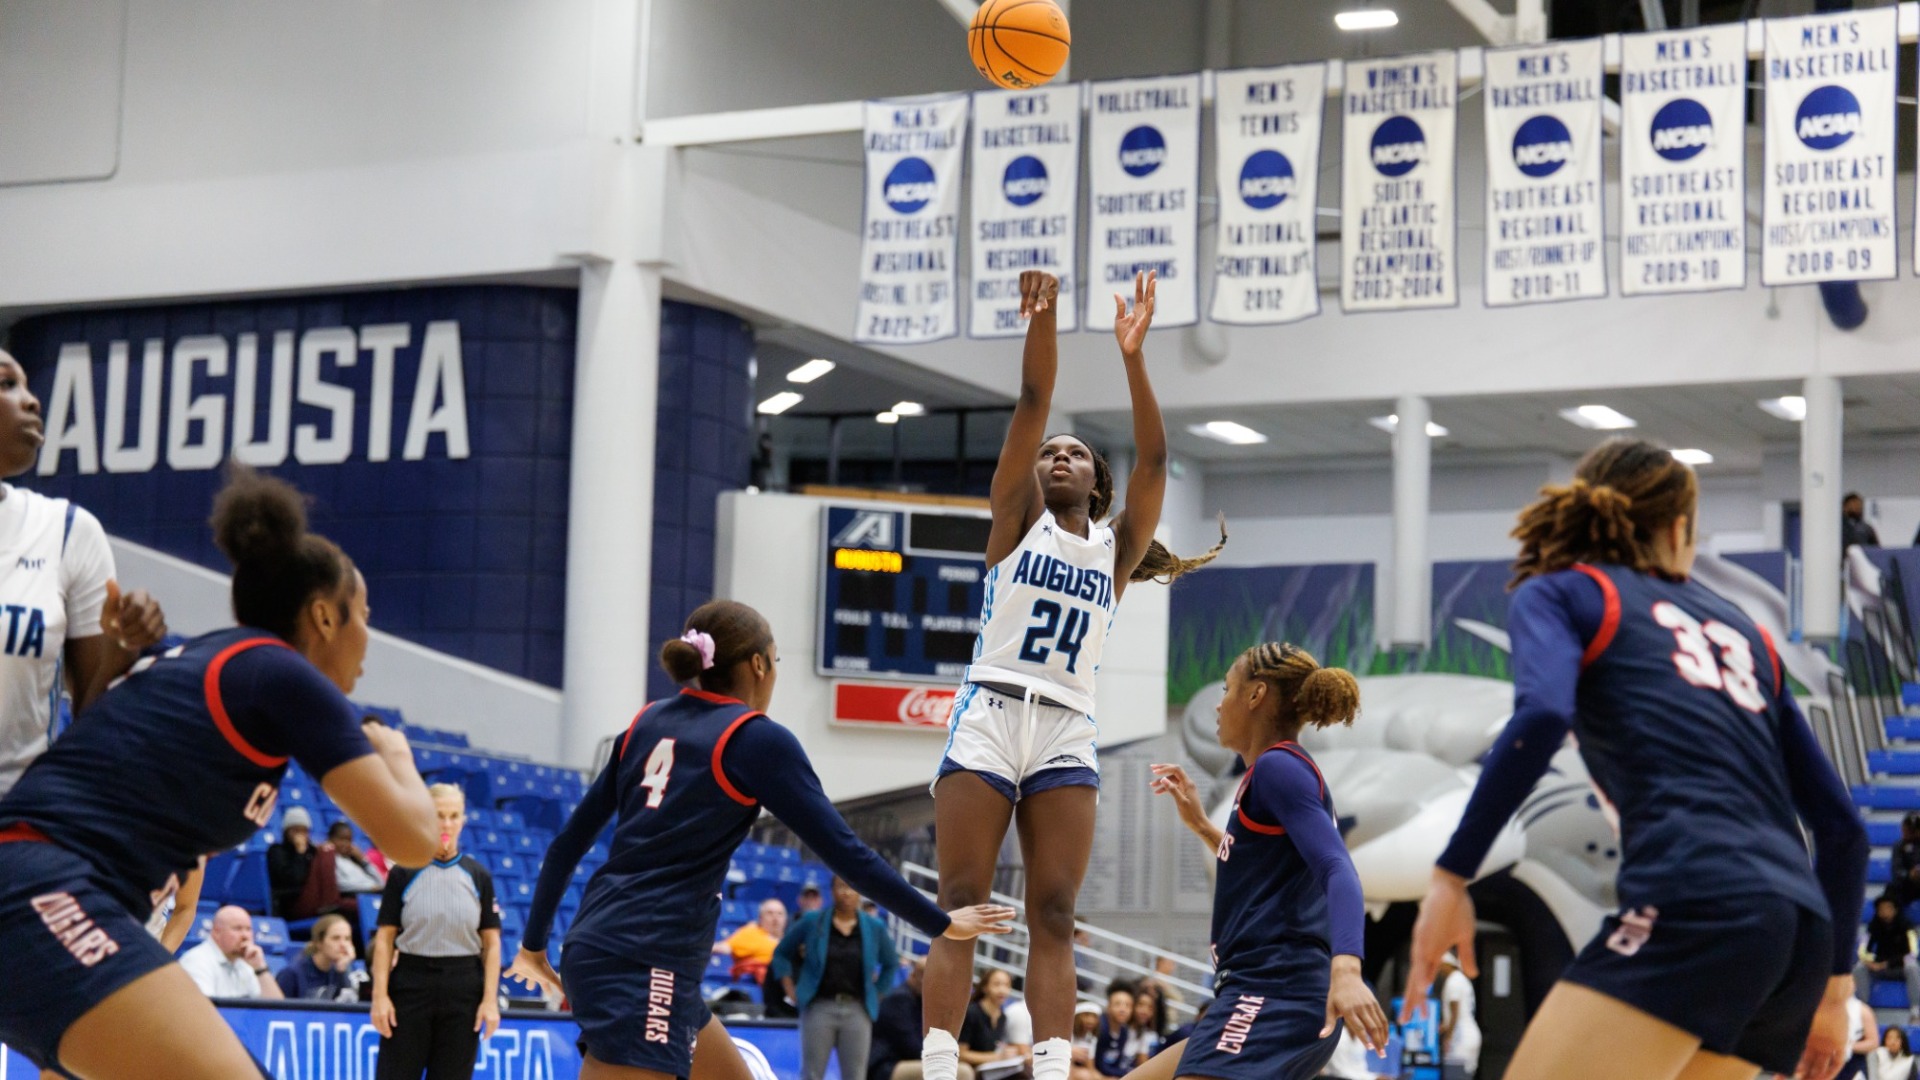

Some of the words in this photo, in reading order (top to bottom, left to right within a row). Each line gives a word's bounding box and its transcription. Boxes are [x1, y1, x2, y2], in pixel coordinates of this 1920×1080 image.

[1801, 22, 1860, 46] MEN'S
[1656, 37, 1711, 60] MEN'S
[1367, 63, 1438, 88] WOMEN'S
[1517, 54, 1570, 77] MEN'S
[1770, 50, 1889, 79] BASKETBALL
[1626, 64, 1737, 93] BASKETBALL
[1099, 88, 1188, 111] VOLLEYBALL
[1247, 80, 1294, 103] MEN'S
[1349, 87, 1452, 114] BASKETBALL
[1492, 80, 1596, 107] BASKETBALL
[1240, 114, 1300, 136] TENNIS
[1652, 125, 1714, 150] NCAA
[1799, 113, 1862, 138] NCAA
[1631, 170, 1735, 197] SOUTHEAST
[1776, 158, 1885, 185] SOUTHEAST
[1098, 191, 1185, 212] SOUTHEAST
[1374, 180, 1424, 202] SOUTH
[1493, 182, 1594, 210] SOUTHEAST
[1783, 188, 1874, 214] REGIONAL
[1361, 205, 1437, 226] ATLANTIC
[1639, 201, 1727, 225] REGIONAL
[980, 218, 1065, 239] SOUTHEAST
[1107, 228, 1174, 247] REGIONAL
[1501, 214, 1587, 239] REGIONAL
[1770, 218, 1890, 246] HOST/CHAMPIONS
[1360, 229, 1436, 250] REGIONAL
[1627, 230, 1740, 255] HOST/CHAMPIONS
[987, 250, 1058, 269] REGIONAL
[1353, 254, 1444, 276] CHAMPIONS
[1642, 260, 1720, 283] 2009-10
[1787, 250, 1872, 275] 2008-09
[1352, 277, 1444, 300] 2003-2004
[1512, 274, 1580, 297] 2010-11
[1245, 289, 1283, 310] 2012
[37, 320, 470, 476] AUGUSTA
[1012, 550, 1111, 612] AUGUSTA
[1018, 598, 1090, 674] 24
[1652, 600, 1767, 714] 33
[640, 737, 677, 808] 4
